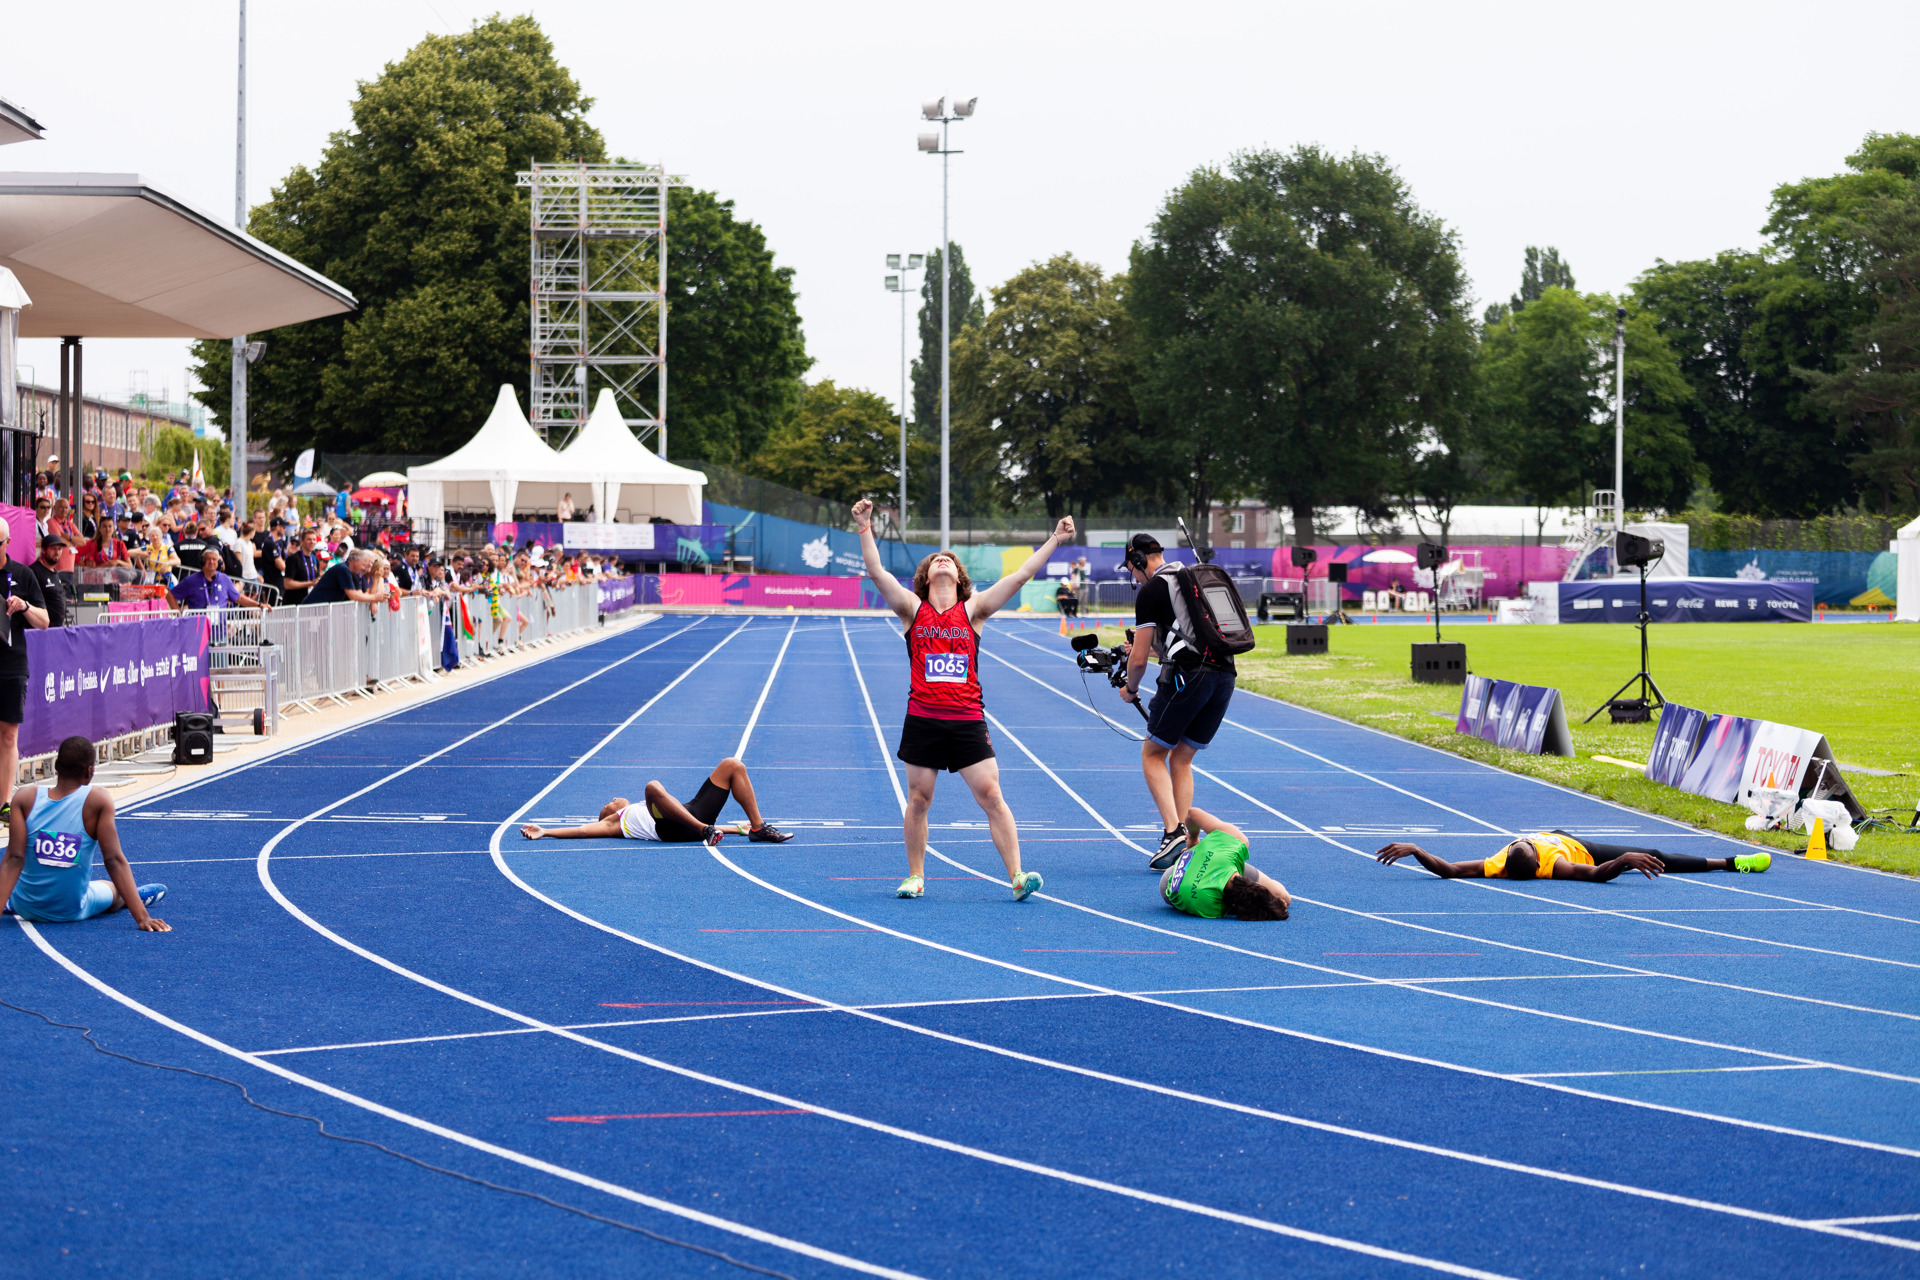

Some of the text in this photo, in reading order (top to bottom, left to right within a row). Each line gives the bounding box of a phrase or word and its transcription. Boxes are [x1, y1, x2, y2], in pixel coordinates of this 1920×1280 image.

[835, 556, 861, 568] WORLD
[1714, 599, 1739, 608] REWE
[1766, 600, 1800, 609] TOYOTA
[915, 625, 970, 640] CANADA
[927, 658, 965, 674] 1065
[1752, 746, 1801, 790] TOYOTA
[35, 838, 77, 859] 1036
[1191, 850, 1213, 899] PAKISTAN
